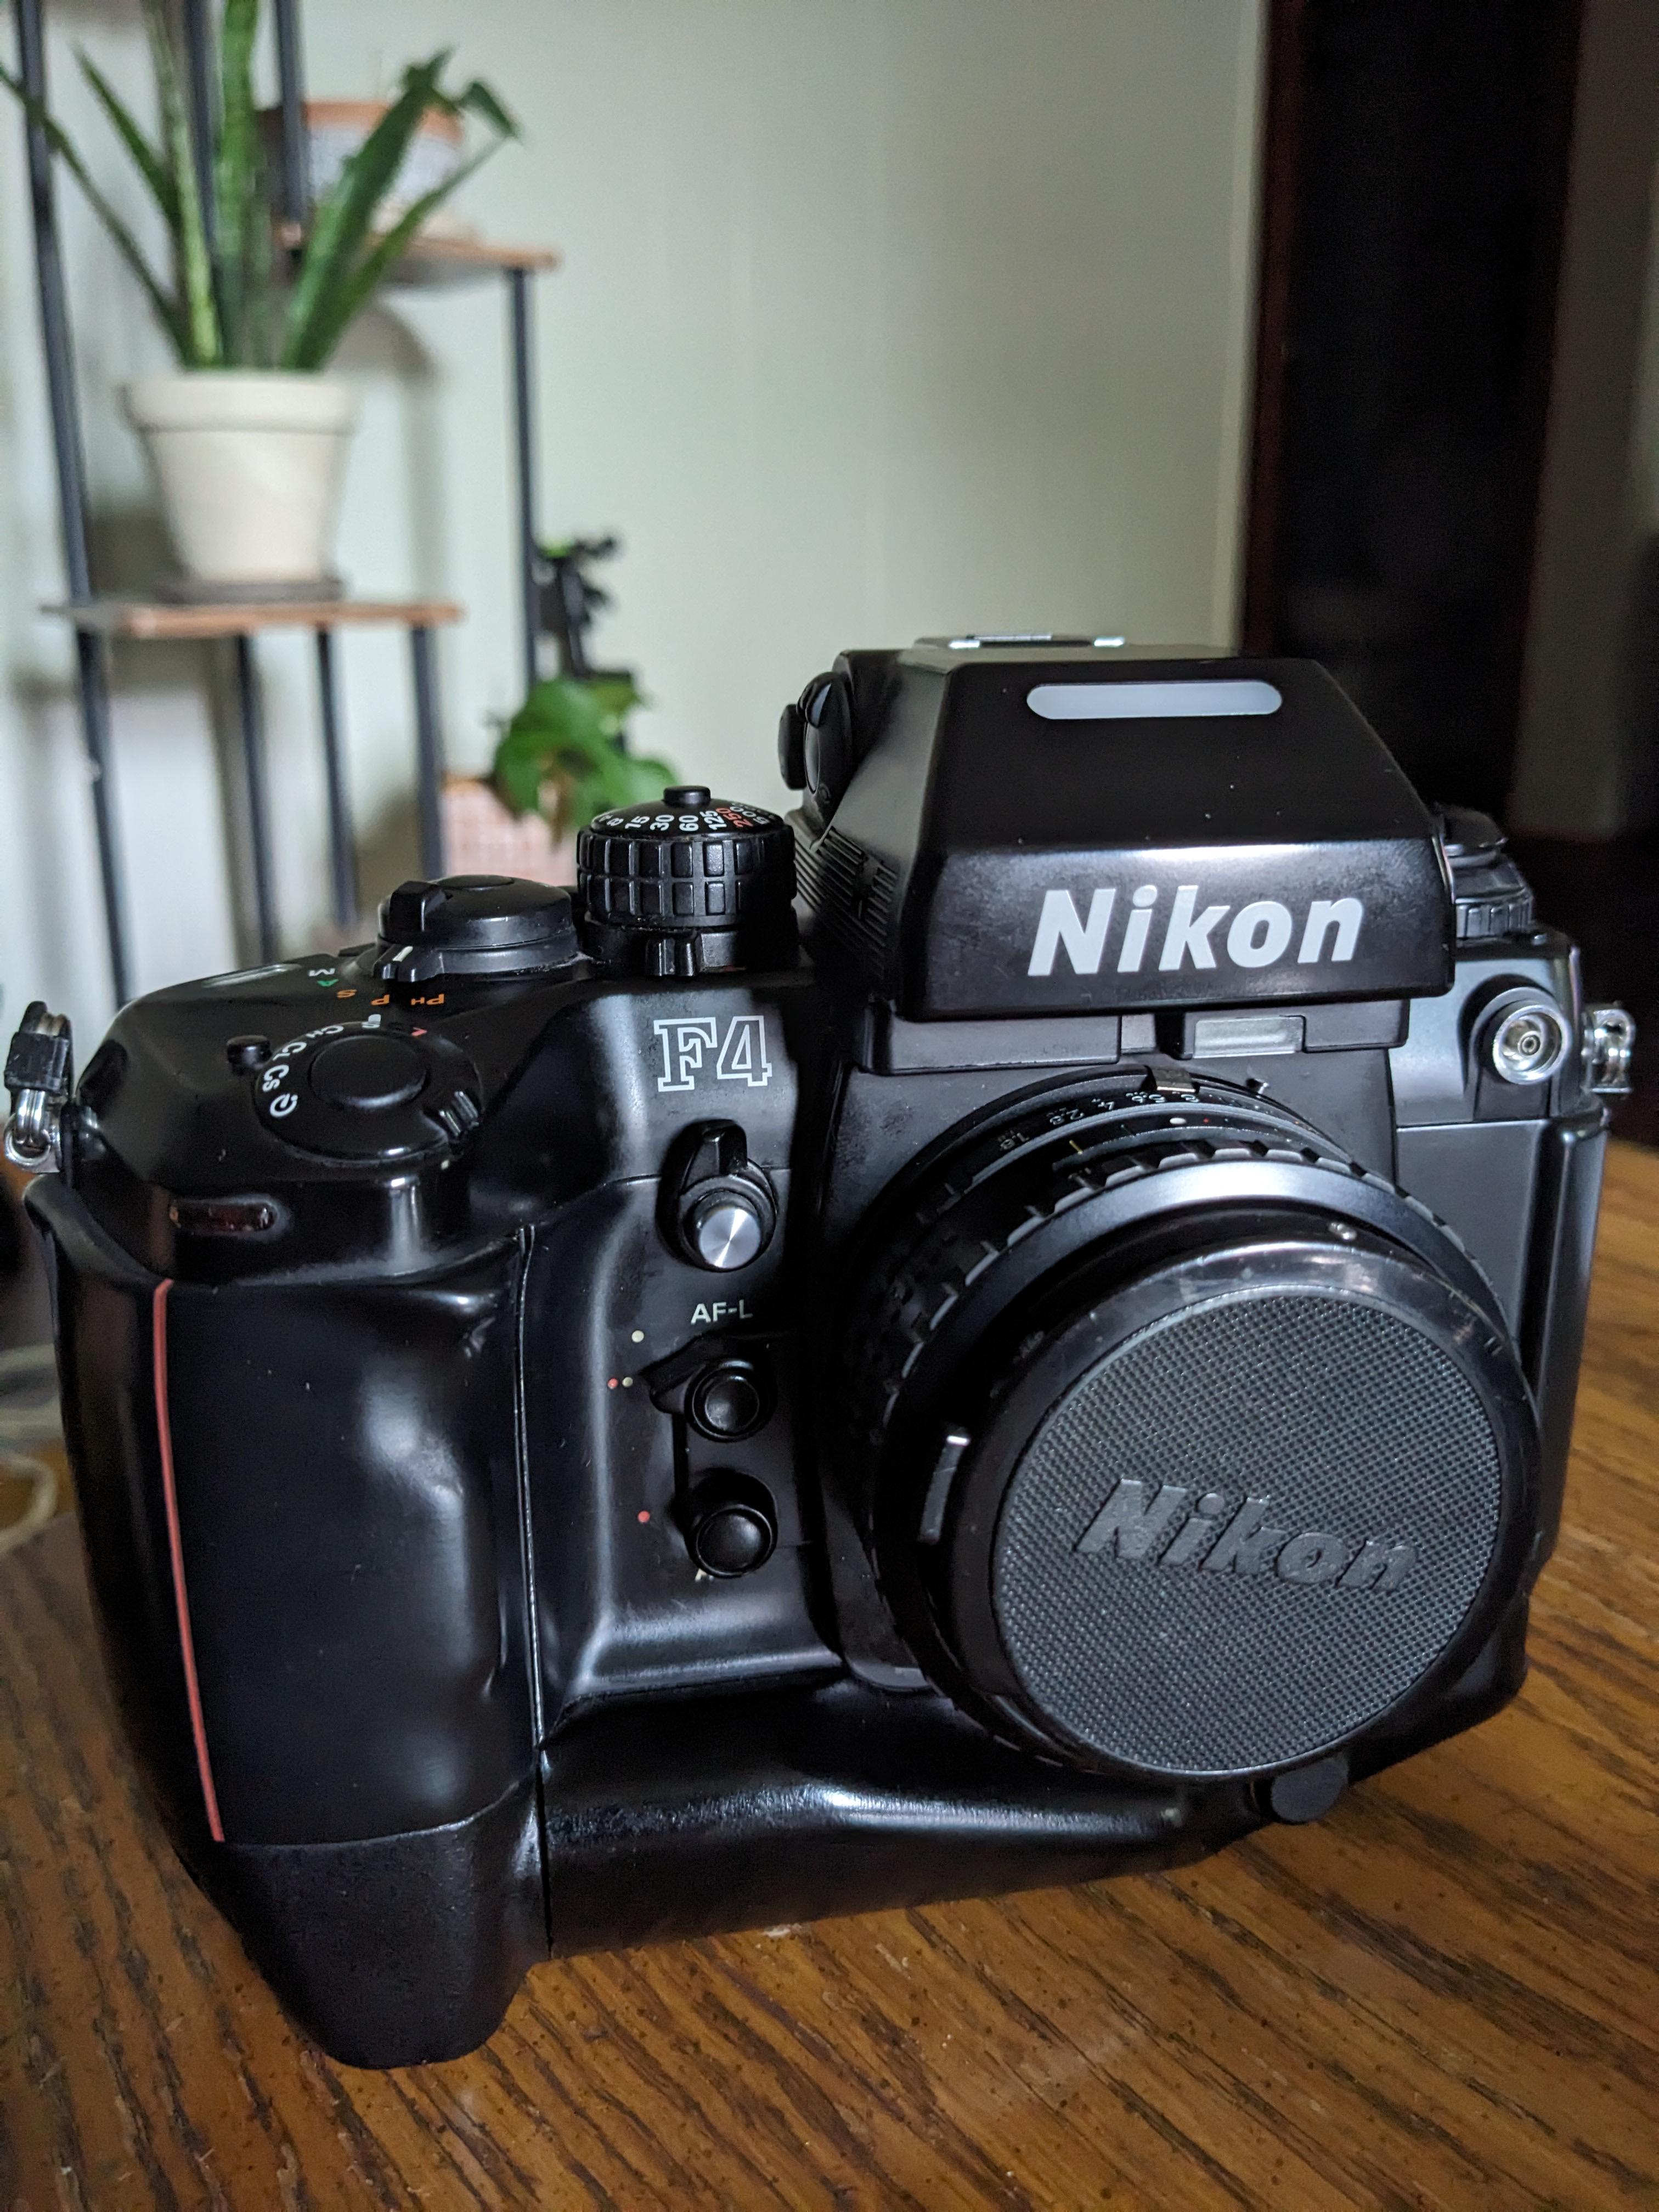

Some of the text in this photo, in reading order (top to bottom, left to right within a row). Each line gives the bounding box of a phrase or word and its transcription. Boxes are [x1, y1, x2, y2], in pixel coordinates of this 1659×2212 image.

[606, 817, 624, 827] 8
[624, 815, 650, 830] 15
[650, 814, 675, 831] 30
[679, 815, 699, 832] 60
[700, 809, 727, 831] 125
[715, 807, 754, 828] 250
[729, 806, 771, 825] 500
[1027, 884, 1364, 977] Nikon
[308, 968, 335, 977] M
[336, 989, 358, 999] S
[370, 994, 391, 1006] P
[653, 1015, 772, 1092] F4
[691, 1299, 754, 1325] AF-L
[1073, 1478, 1418, 1594] Nikon
